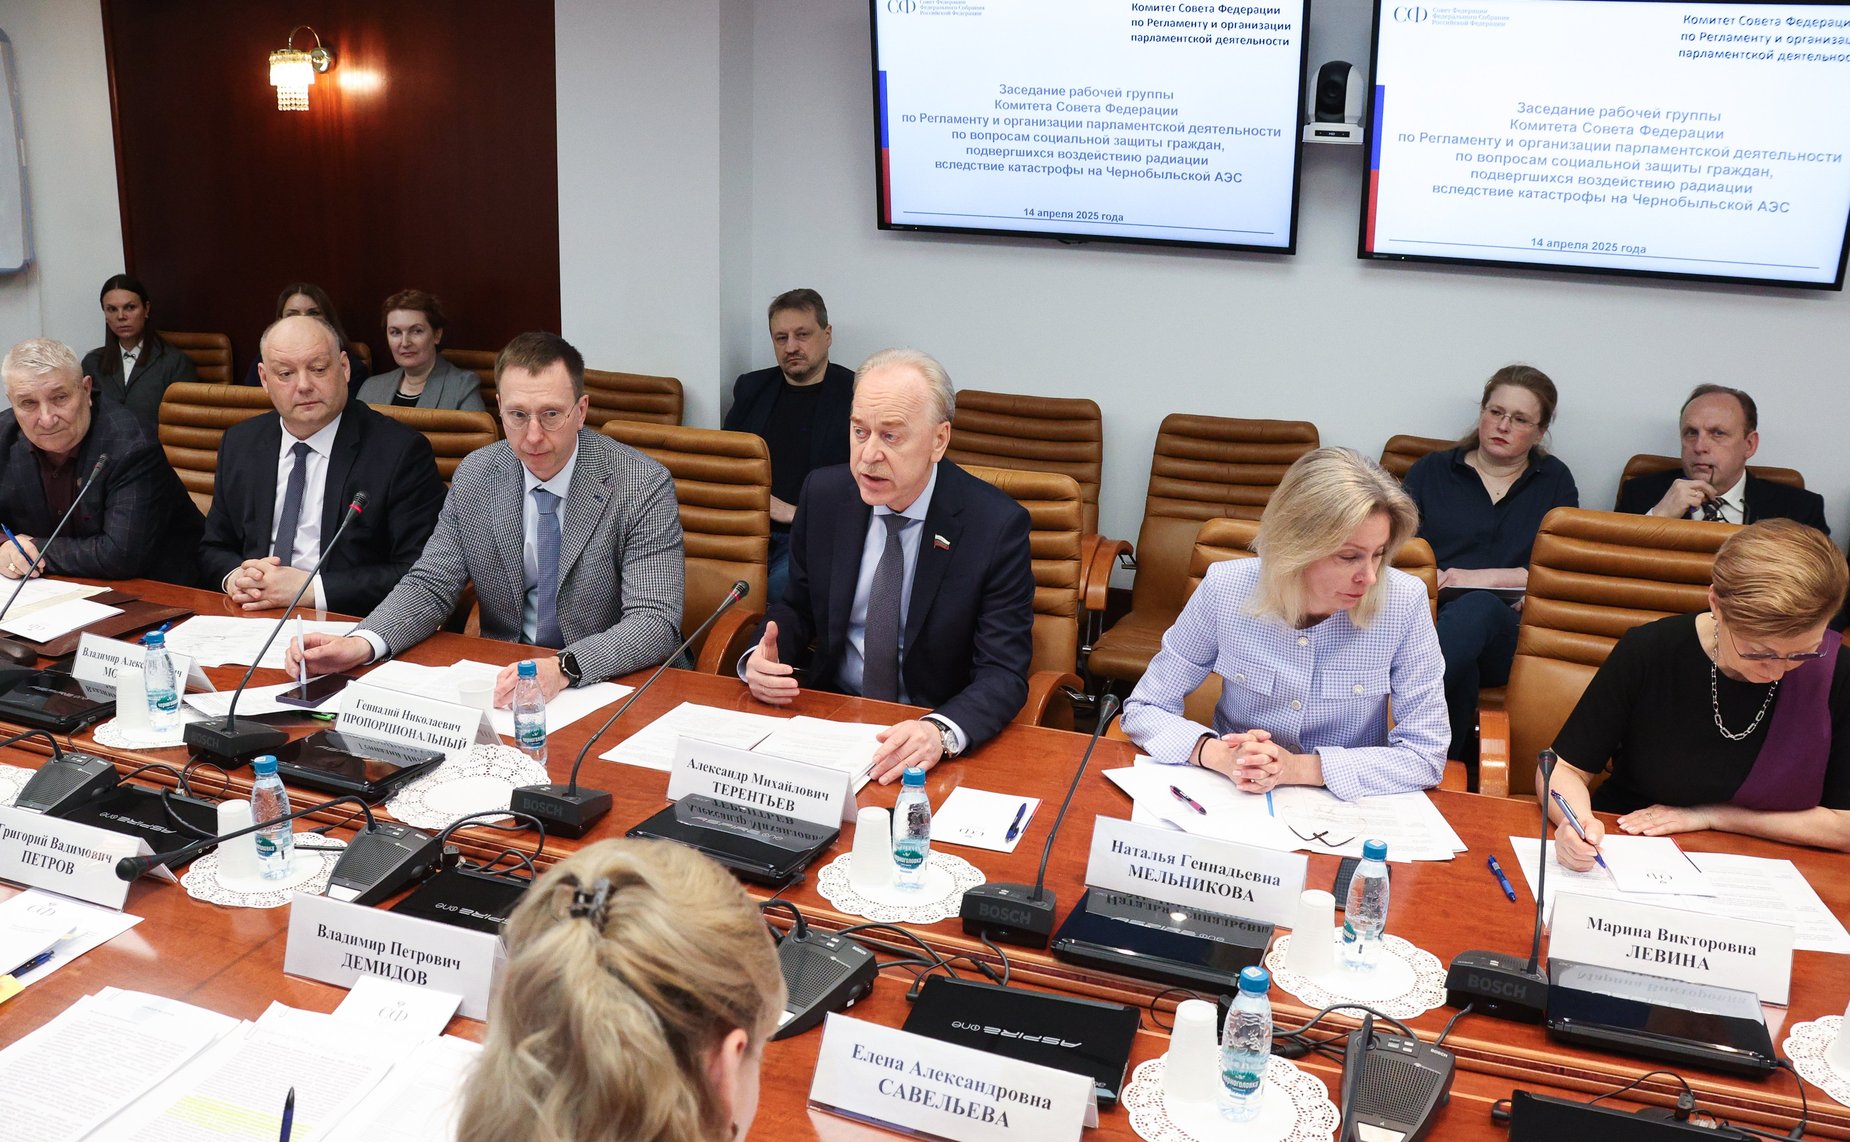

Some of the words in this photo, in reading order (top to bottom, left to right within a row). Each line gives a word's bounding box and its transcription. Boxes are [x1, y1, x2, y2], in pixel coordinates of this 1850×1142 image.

[1131, 2, 1176, 13] Комитет
[1178, 3, 1215, 14] Совета
[1217, 4, 1281, 17] Федерации
[1683, 15, 1736, 26] Комитет
[1738, 15, 1782, 27] Совета
[1131, 19, 1145, 27] по
[1146, 18, 1209, 31] Регламенту
[1210, 21, 1218, 29] и
[1220, 21, 1292, 32] организации
[1130, 33, 1213, 44] парламентской
[1214, 36, 1290, 46] деятельности
[1680, 33, 1696, 42] по
[1699, 31, 1772, 46] Регламенту
[1678, 49, 1775, 61] парламентской
[999, 83, 1067, 97] Заседание
[1069, 86, 1123, 99] рабочей
[1125, 90, 1174, 102] группы
[994, 99, 1053, 112] Комитета
[1055, 100, 1102, 114] Совета
[1104, 102, 1179, 118] Федерации
[1516, 101, 1596, 117] Заседание
[1598, 105, 1662, 120] рабочей
[1665, 110, 1722, 124] группы
[901, 114, 917, 123] по
[919, 112, 990, 128] Регламенту
[992, 117, 1000, 126] и
[1003, 117, 1083, 130] организации
[1086, 120, 1186, 133] парламентской
[1187, 124, 1282, 138] деятельности
[1509, 118, 1578, 133] Комитета
[1582, 121, 1635, 136] Совета
[1639, 124, 1725, 141] Федерации
[951, 130, 967, 140] по
[969, 131, 1031, 144] вопросам
[1032, 134, 1110, 145] социальной
[1113, 137, 1163, 149] защиты
[1166, 139, 1225, 153] граждан,
[1398, 133, 1416, 143] по
[1419, 131, 1502, 150] Регламенту
[1505, 138, 1514, 148] и
[1518, 138, 1612, 153] организации
[1615, 143, 1731, 158] парламентской
[1732, 149, 1843, 163] деятельности
[965, 146, 1055, 159] подвергшихся
[1057, 150, 1142, 163] воздействию
[1145, 154, 1209, 167] радиации
[1455, 152, 1473, 162] по
[1476, 153, 1548, 167] вопросам
[1551, 157, 1641, 171] социальной
[1644, 162, 1702, 174] защиты
[1706, 165, 1774, 179] граждан,
[934, 160, 1005, 172] вследствие
[1007, 163, 1084, 177] катастрофы
[1087, 167, 1103, 177] на
[1105, 165, 1211, 182] Чернобыльской
[1213, 171, 1243, 184] АЭС
[1470, 170, 1574, 184] подвергшихся
[1577, 176, 1676, 190] воздействию
[1679, 181, 1753, 195] радиации
[1432, 184, 1515, 198] вследствие
[1518, 189, 1607, 205] катастрофы
[1610, 194, 1628, 205] на
[1632, 193, 1754, 211] Чернобыльской
[1756, 200, 1791, 214] АЭС
[1023, 208, 1035, 218] 14
[1036, 211, 1074, 221] апреля
[1075, 211, 1100, 221] 2025
[1101, 214, 1124, 223] года
[1530, 238, 1544, 249] 14
[1546, 241, 1589, 252] апреля
[1591, 242, 1618, 253] 2025
[1620, 245, 1647, 254] года
[82, 647, 120, 665] Владимир
[356, 699, 400, 718] Геннадий
[402, 709, 461, 733] Николаевич
[342, 713, 467, 751] ПРОПОРЦИОНАЛЬНЫЙ
[686, 758, 749, 784] Александр
[752, 769, 830, 802] Михайлович
[523, 798, 562, 817] BOSCH
[712, 780, 796, 812] ТЕРЕНТЬЕВ
[50, 837, 113, 864] Вадимович
[20, 850, 75, 876] ПЕТРОВ
[1111, 840, 1176, 865] Наталья
[1180, 854, 1281, 887] Геннадьевна
[1128, 864, 1255, 903] МЕЛЬНИКОВА
[458, 908, 511, 925] SPIRE
[979, 902, 1032, 925] BOSCH
[317, 924, 386, 956] Владимир
[390, 942, 461, 970] Петрович
[1586, 916, 1652, 940] Марина
[1657, 928, 1757, 957] Викторовна
[341, 952, 428, 986] ДЕМИДОВ
[1625, 944, 1710, 972] ЛЕВИНА
[1467, 974, 1528, 1000] BOSCH
[951, 1020, 980, 1032] one
[983, 1026, 1082, 1048] ASPIRE
[851, 1043, 904, 1072] Елена
[909, 1060, 1052, 1110] Александровна
[878, 1078, 1010, 1128] САВЕЛЬЕВА
